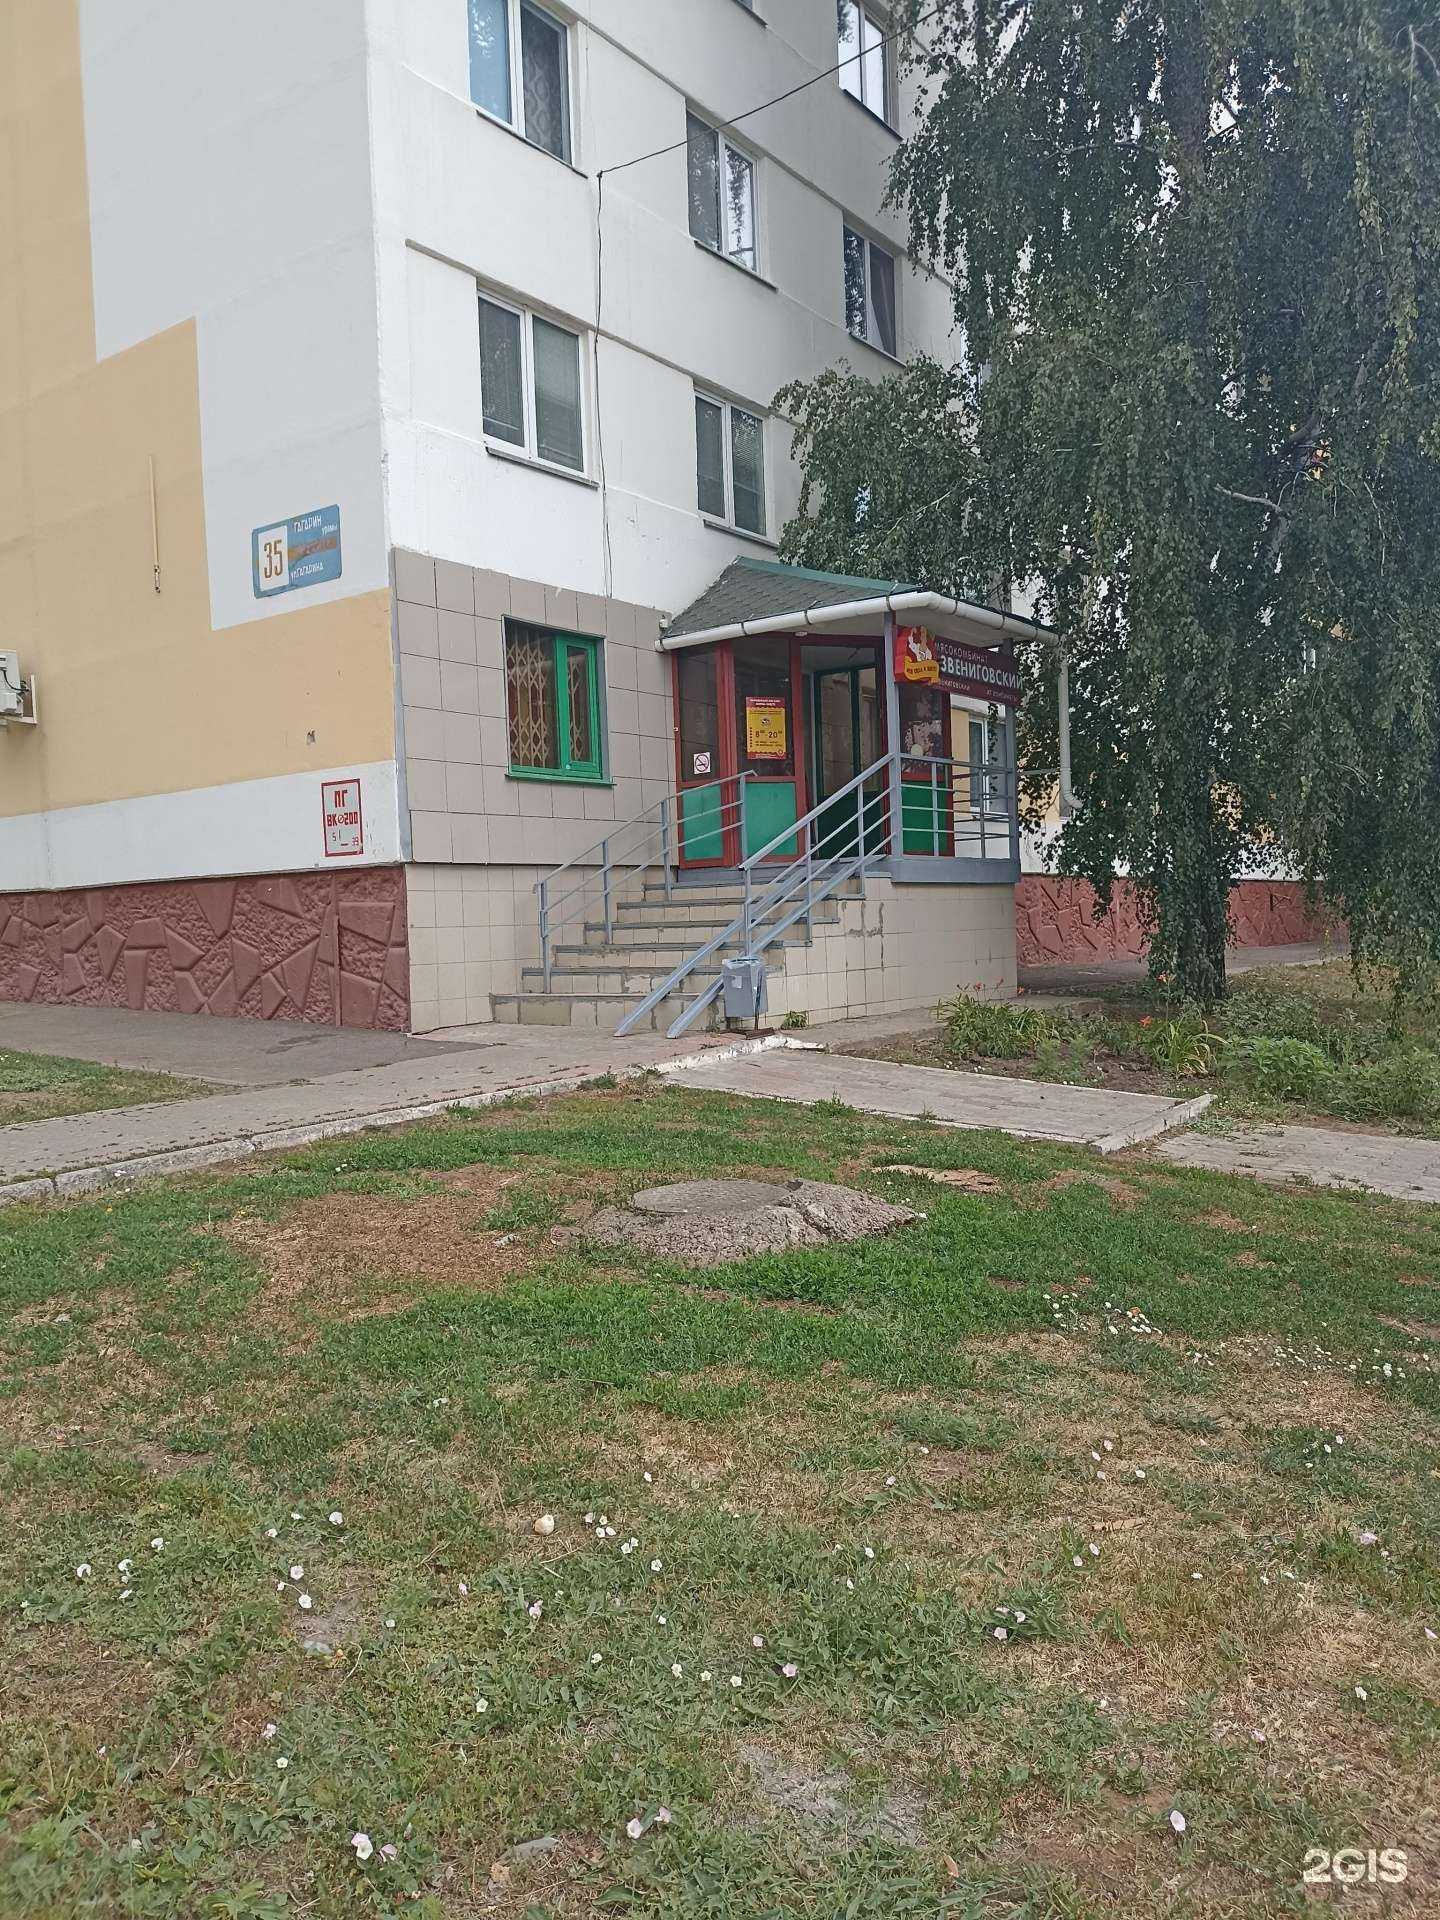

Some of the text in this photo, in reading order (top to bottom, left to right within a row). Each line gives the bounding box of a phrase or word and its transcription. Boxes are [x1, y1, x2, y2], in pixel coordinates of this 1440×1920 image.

[264, 539, 283, 579] 35
[935, 641, 988, 664] МЯСОКОМБИНАТ
[941, 655, 1024, 689] ЗВЕНИГОВСКИЙ
[334, 789, 347, 808] ПГ
